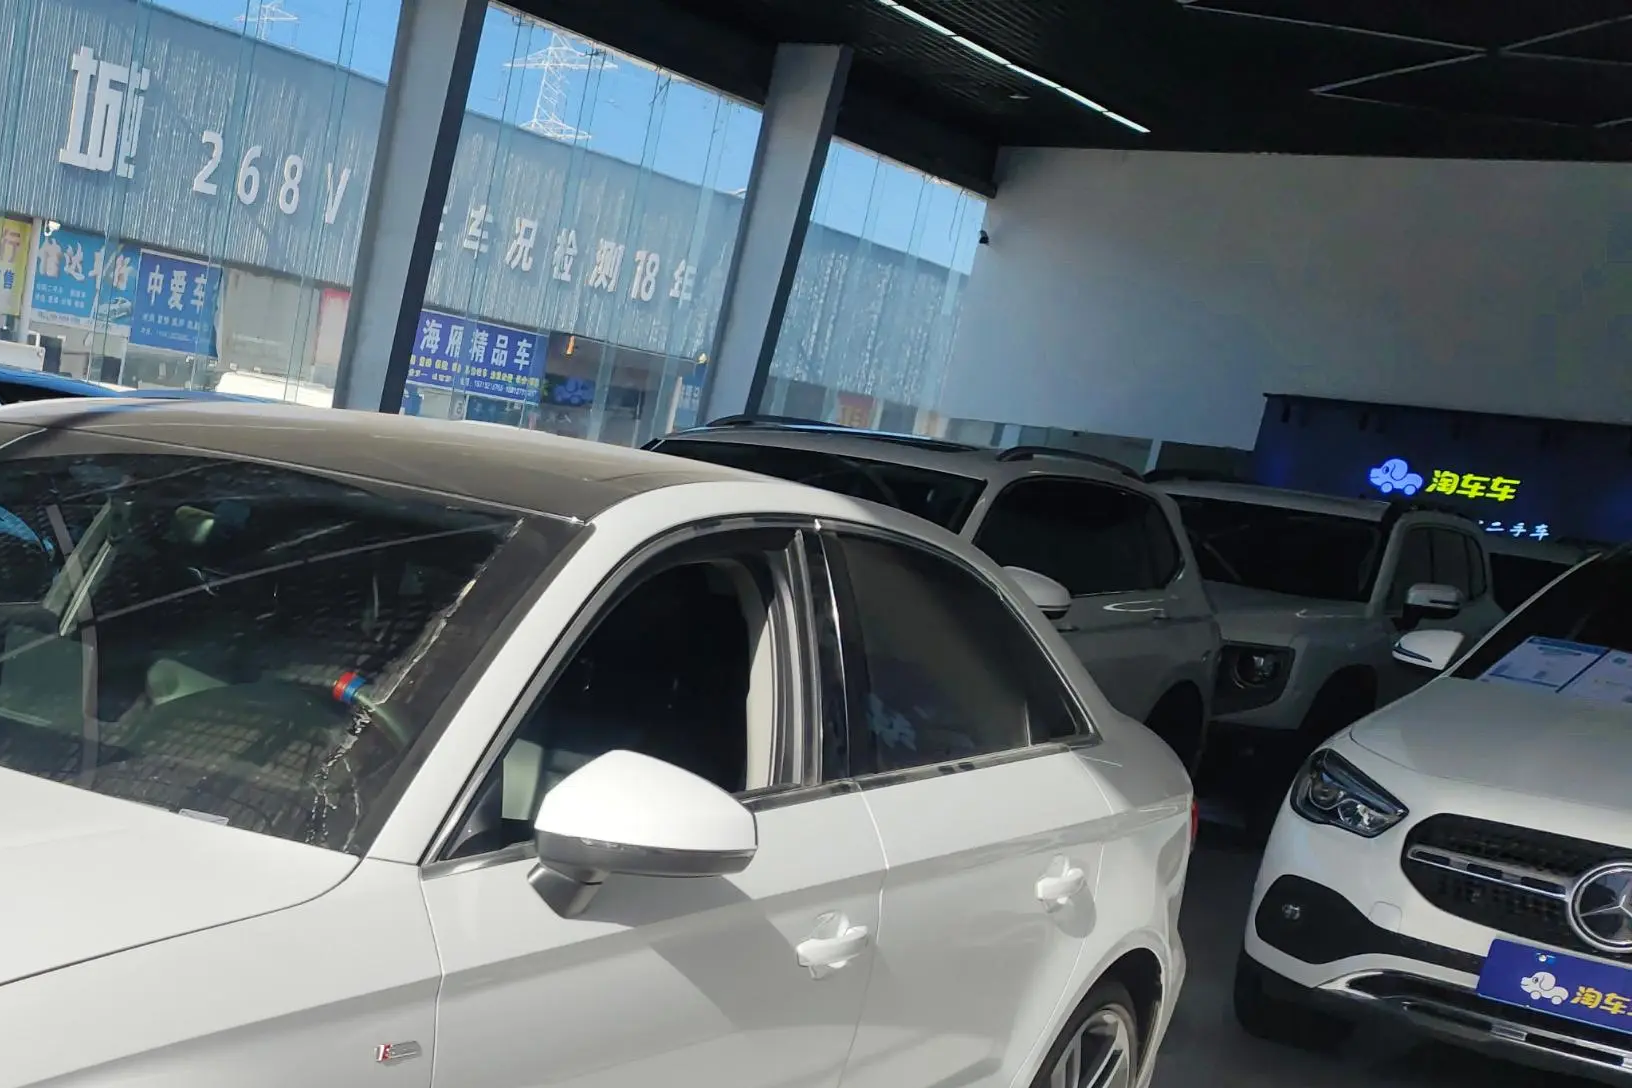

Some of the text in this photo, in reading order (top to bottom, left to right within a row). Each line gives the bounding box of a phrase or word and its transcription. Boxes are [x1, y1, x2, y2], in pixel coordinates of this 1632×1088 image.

[434, 203, 699, 309] 车况检测18年
[1425, 470, 1521, 501] 淘车车
[1478, 520, 1550, 541] 二手车
[1570, 986, 1632, 1017] 淘车
